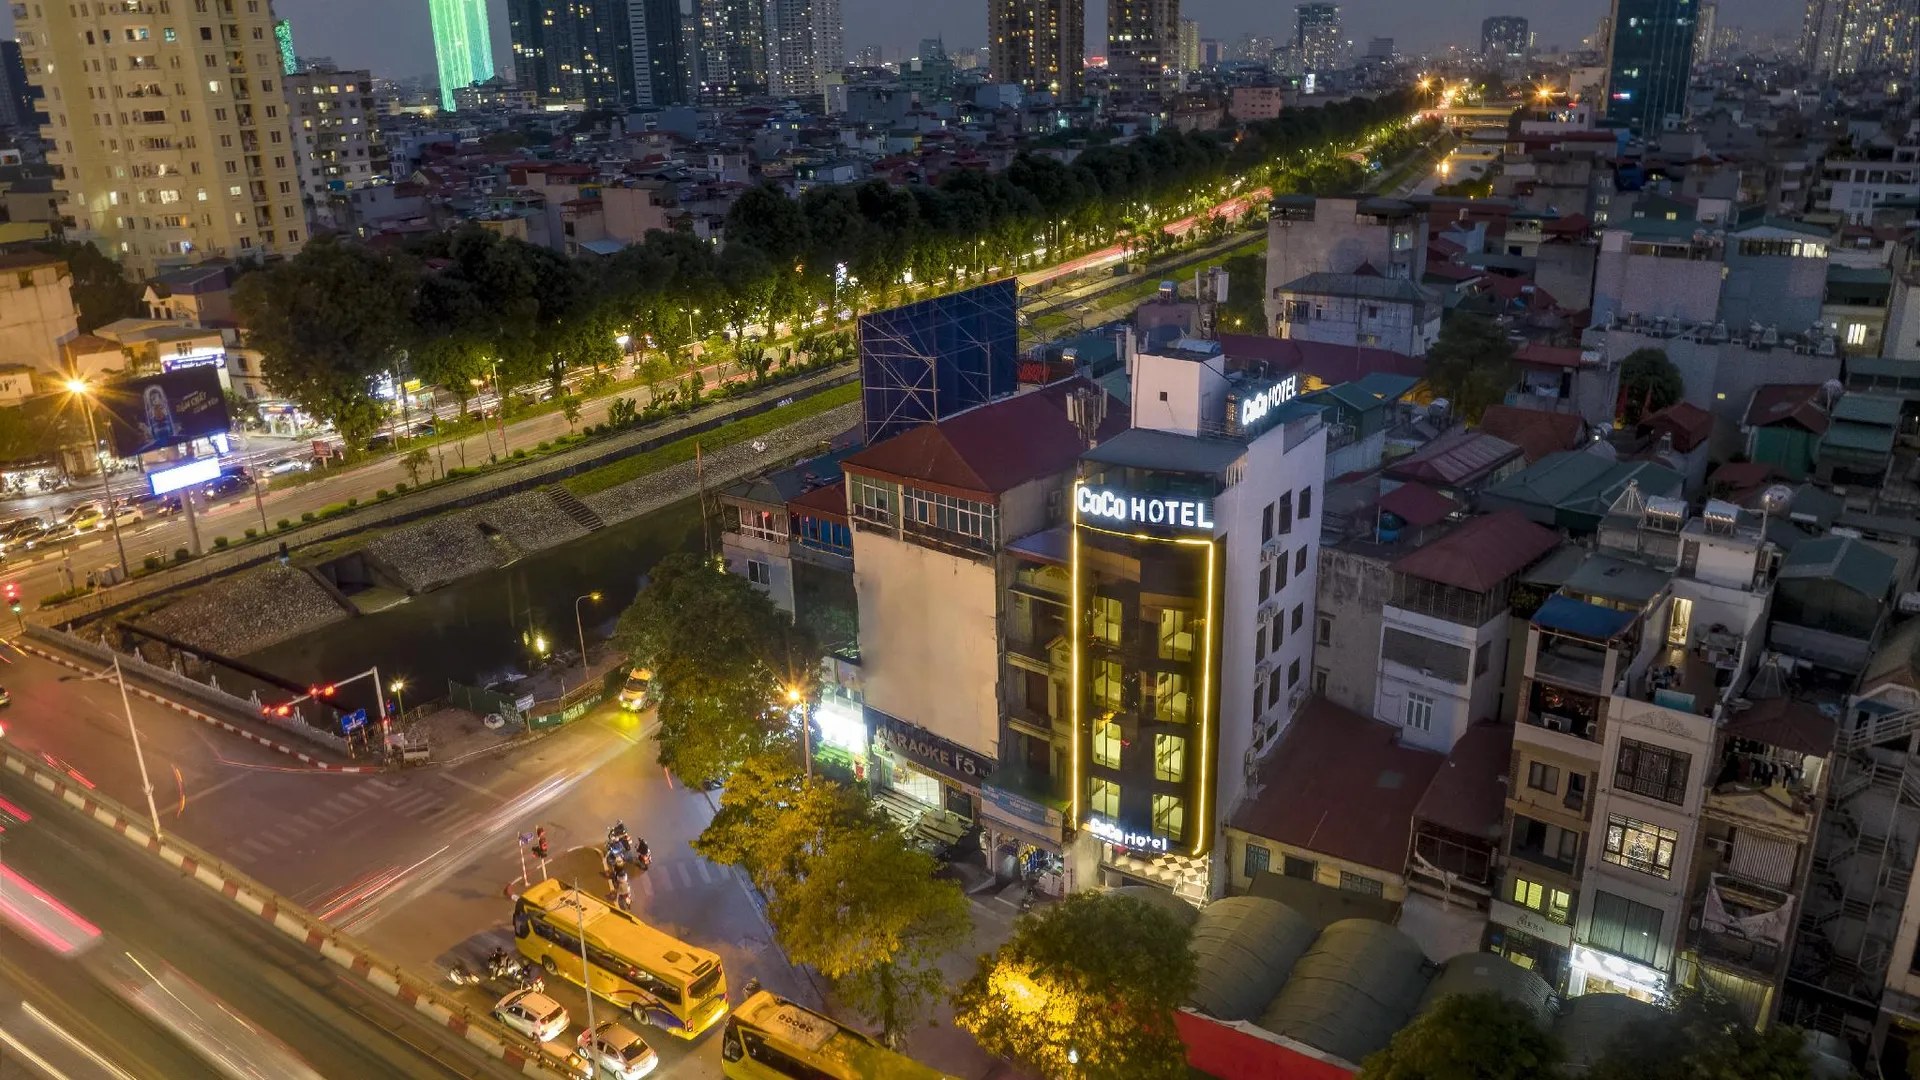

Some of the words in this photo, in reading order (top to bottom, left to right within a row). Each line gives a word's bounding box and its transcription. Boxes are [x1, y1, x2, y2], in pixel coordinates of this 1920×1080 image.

[1242, 392, 1267, 426] CoCo
[1268, 375, 1297, 409] HOTEL
[1077, 486, 1126, 520] CoCo
[1131, 497, 1214, 529] HOTEL
[876, 725, 949, 764] KARAOKE
[955, 752, 977, 776] F5
[1125, 832, 1167, 851] Hotel
